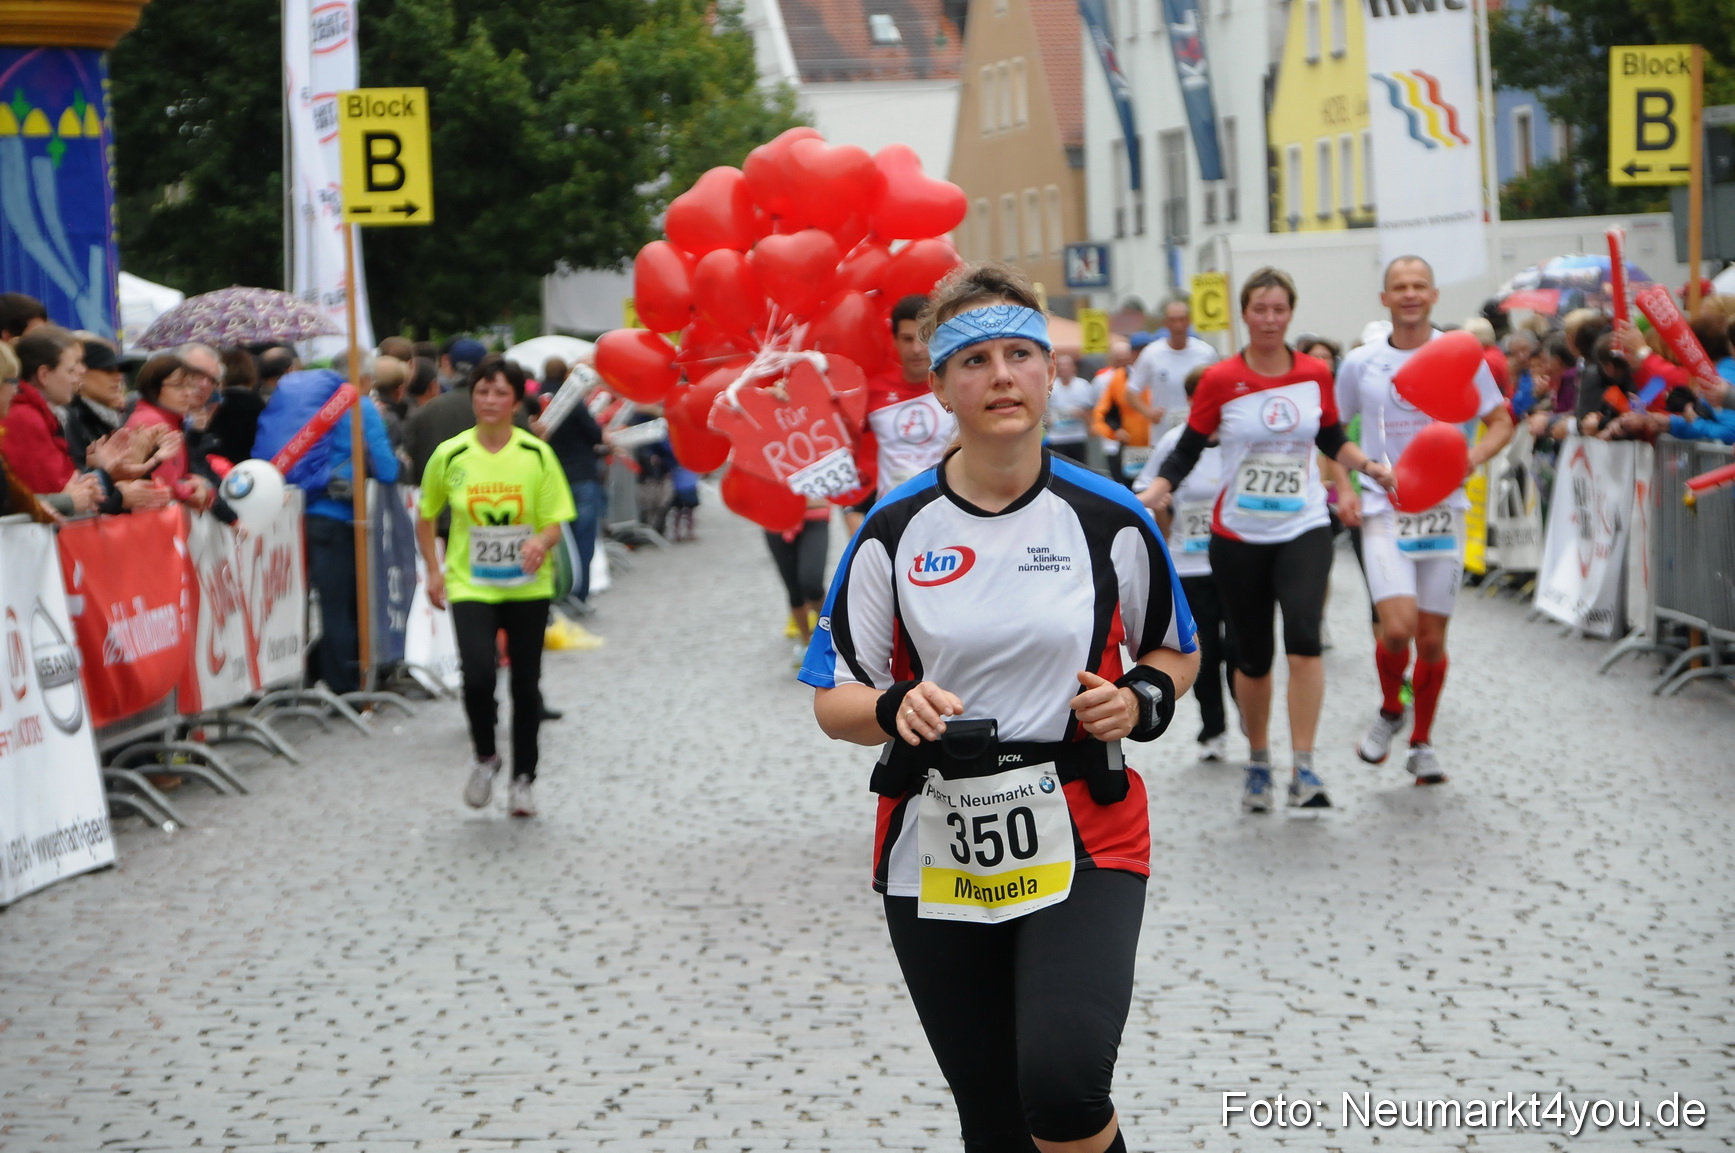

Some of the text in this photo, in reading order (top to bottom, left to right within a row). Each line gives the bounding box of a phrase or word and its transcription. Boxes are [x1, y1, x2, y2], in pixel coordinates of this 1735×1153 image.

[1622, 51, 1691, 75] Block
[347, 95, 417, 118] Block
[1636, 91, 1677, 151] B
[363, 131, 406, 192] B
[1200, 289, 1222, 319] C
[774, 406, 808, 431] für
[467, 482, 523, 495] Müller
[801, 463, 857, 499] 3333
[1245, 469, 1300, 494] 2725
[1398, 511, 1453, 536] 2722
[913, 552, 956, 573] tkn
[1018, 563, 1060, 572] nürnberg
[1033, 554, 1071, 563] klinikum
[960, 783, 1035, 808] Neumarkt
[947, 806, 1039, 868] 350
[954, 876, 1038, 903] Manuela
